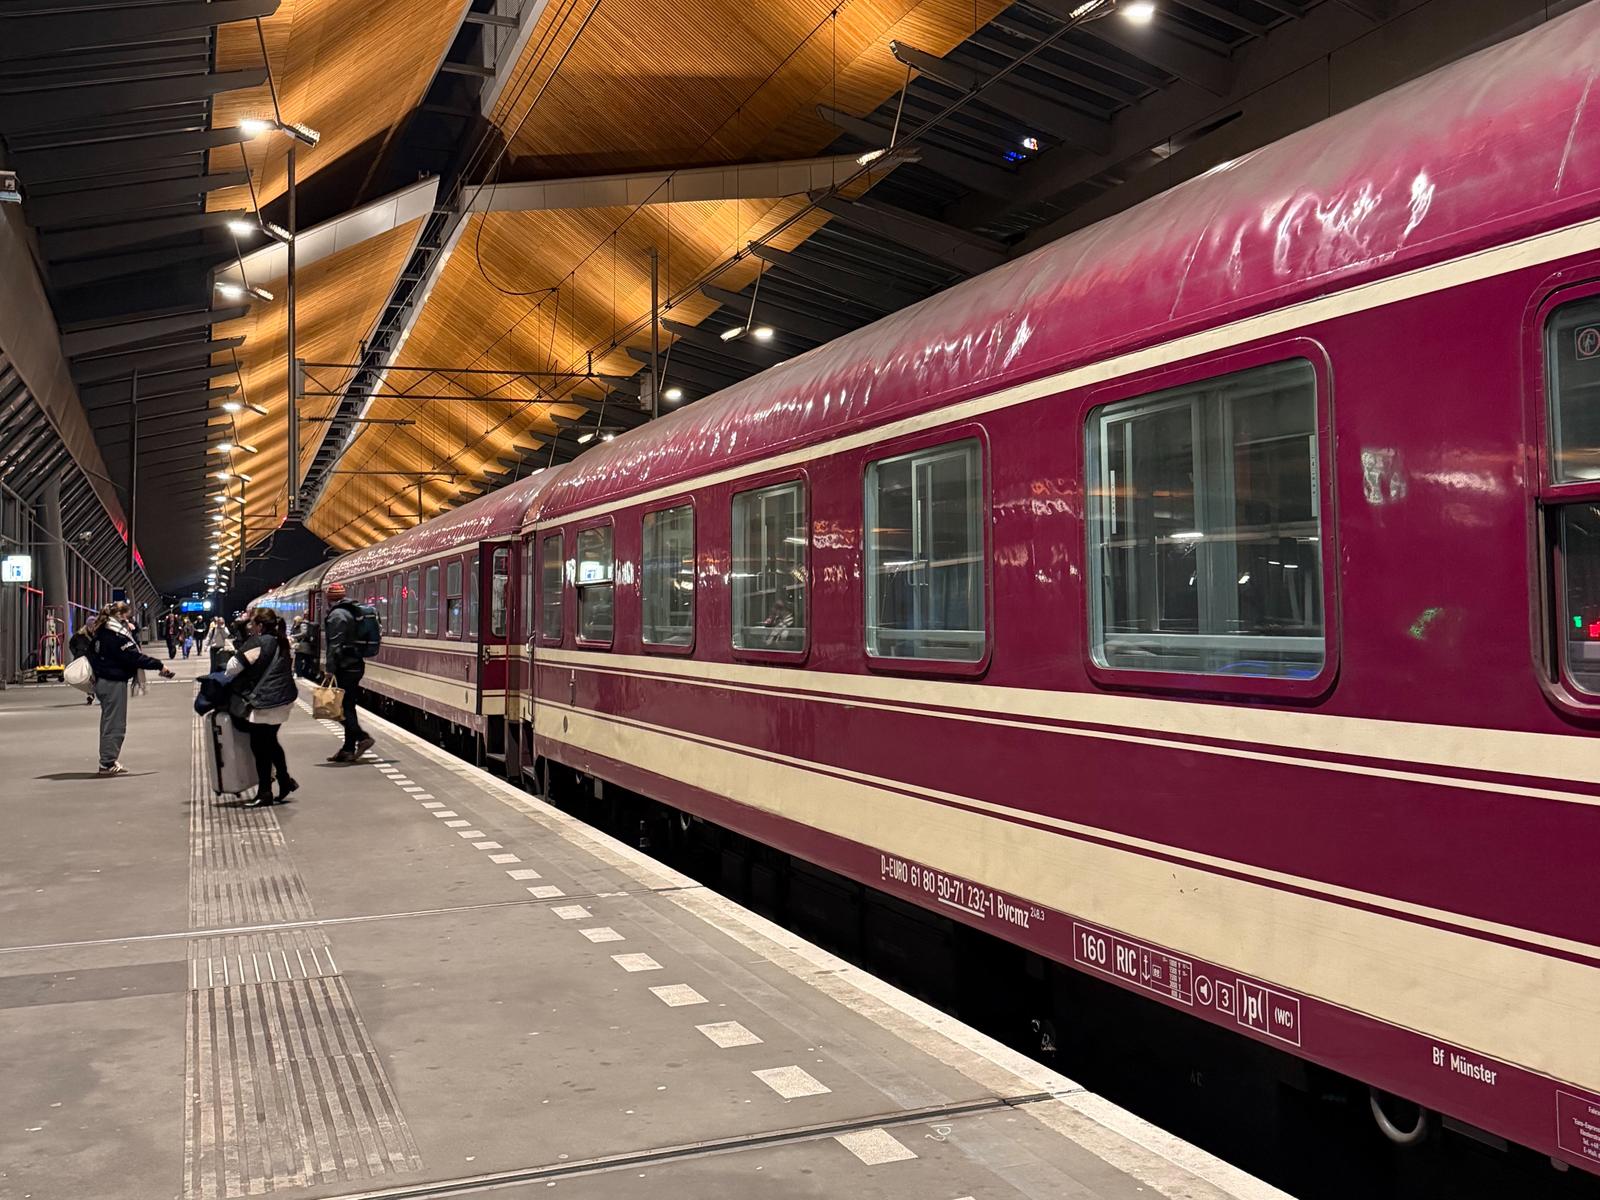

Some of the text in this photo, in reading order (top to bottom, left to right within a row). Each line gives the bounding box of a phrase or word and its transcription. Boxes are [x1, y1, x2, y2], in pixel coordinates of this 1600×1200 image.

[881, 854, 908, 883] D-EURO
[910, 865, 921, 888] 61
[923, 870, 935, 894] 80
[937, 874, 964, 904] 50-71
[967, 885, 994, 916] 232-1
[997, 894, 1030, 929] Bvcmz
[1081, 932, 1106, 965] 160
[1116, 944, 1137, 977] RIC
[1221, 988, 1229, 1008] 3
[1274, 1006, 1294, 1029] (WC)
[1432, 1046, 1497, 1086] Bf Münster
